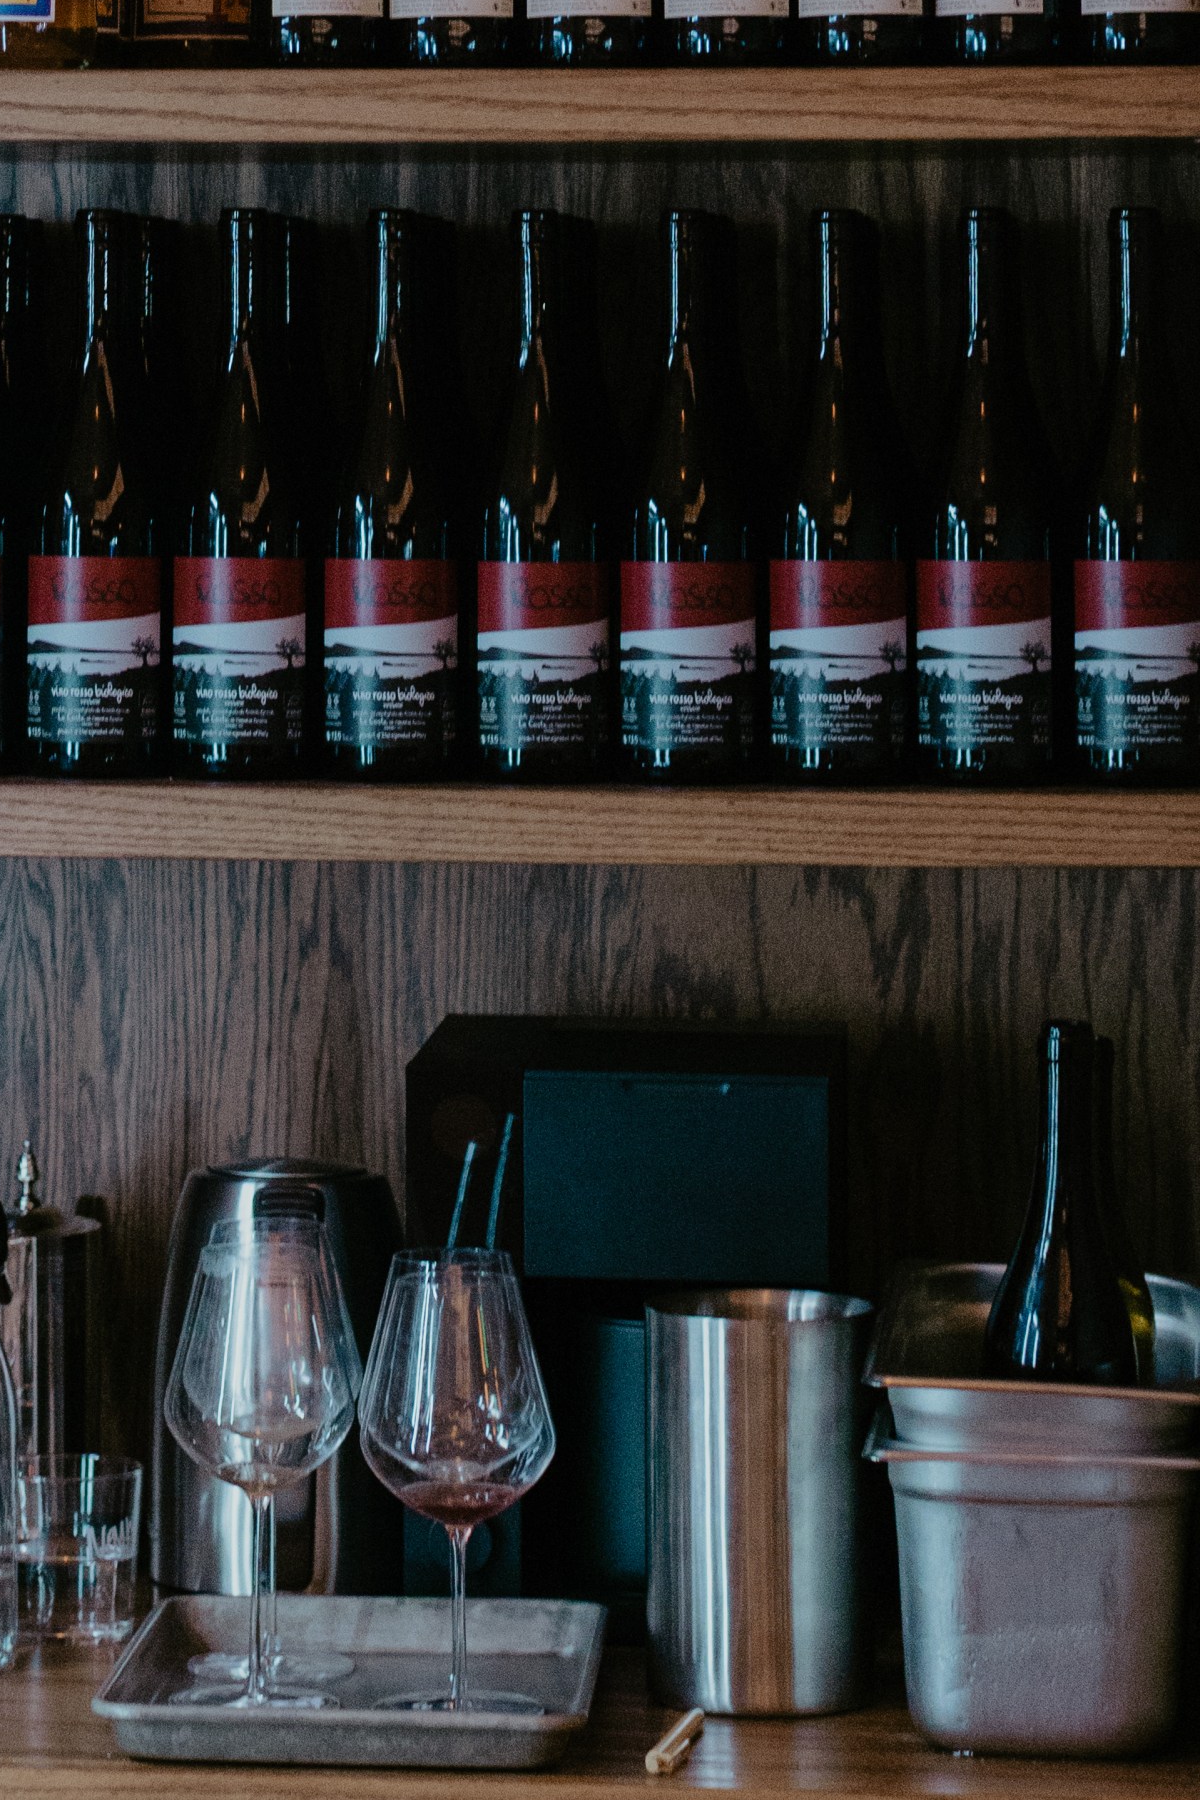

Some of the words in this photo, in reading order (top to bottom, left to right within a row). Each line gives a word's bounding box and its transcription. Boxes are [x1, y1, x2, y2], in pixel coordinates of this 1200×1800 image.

[51, 686, 68, 698] vino
[69, 687, 93, 698] rosso
[94, 682, 133, 704] biologico
[196, 688, 212, 699] vino
[214, 688, 237, 699] rosso
[238, 683, 278, 705] biologico
[352, 690, 371, 701] vino
[372, 690, 396, 701] rosso
[397, 685, 434, 707] biologico
[511, 694, 530, 704] vino
[531, 694, 555, 704] rosso
[556, 689, 591, 710] biologico
[649, 694, 668, 704] vino
[669, 694, 693, 704] rosso
[694, 688, 732, 710] biologico
[798, 693, 816, 703] vino
[818, 693, 842, 703] rosso
[843, 687, 882, 710] biologico
[939, 694, 956, 704] vino
[958, 694, 981, 704] rosso
[982, 688, 1023, 710] biologico
[1106, 694, 1125, 704] vino
[1126, 694, 1150, 704] rosso
[1151, 689, 1189, 711] biologico
